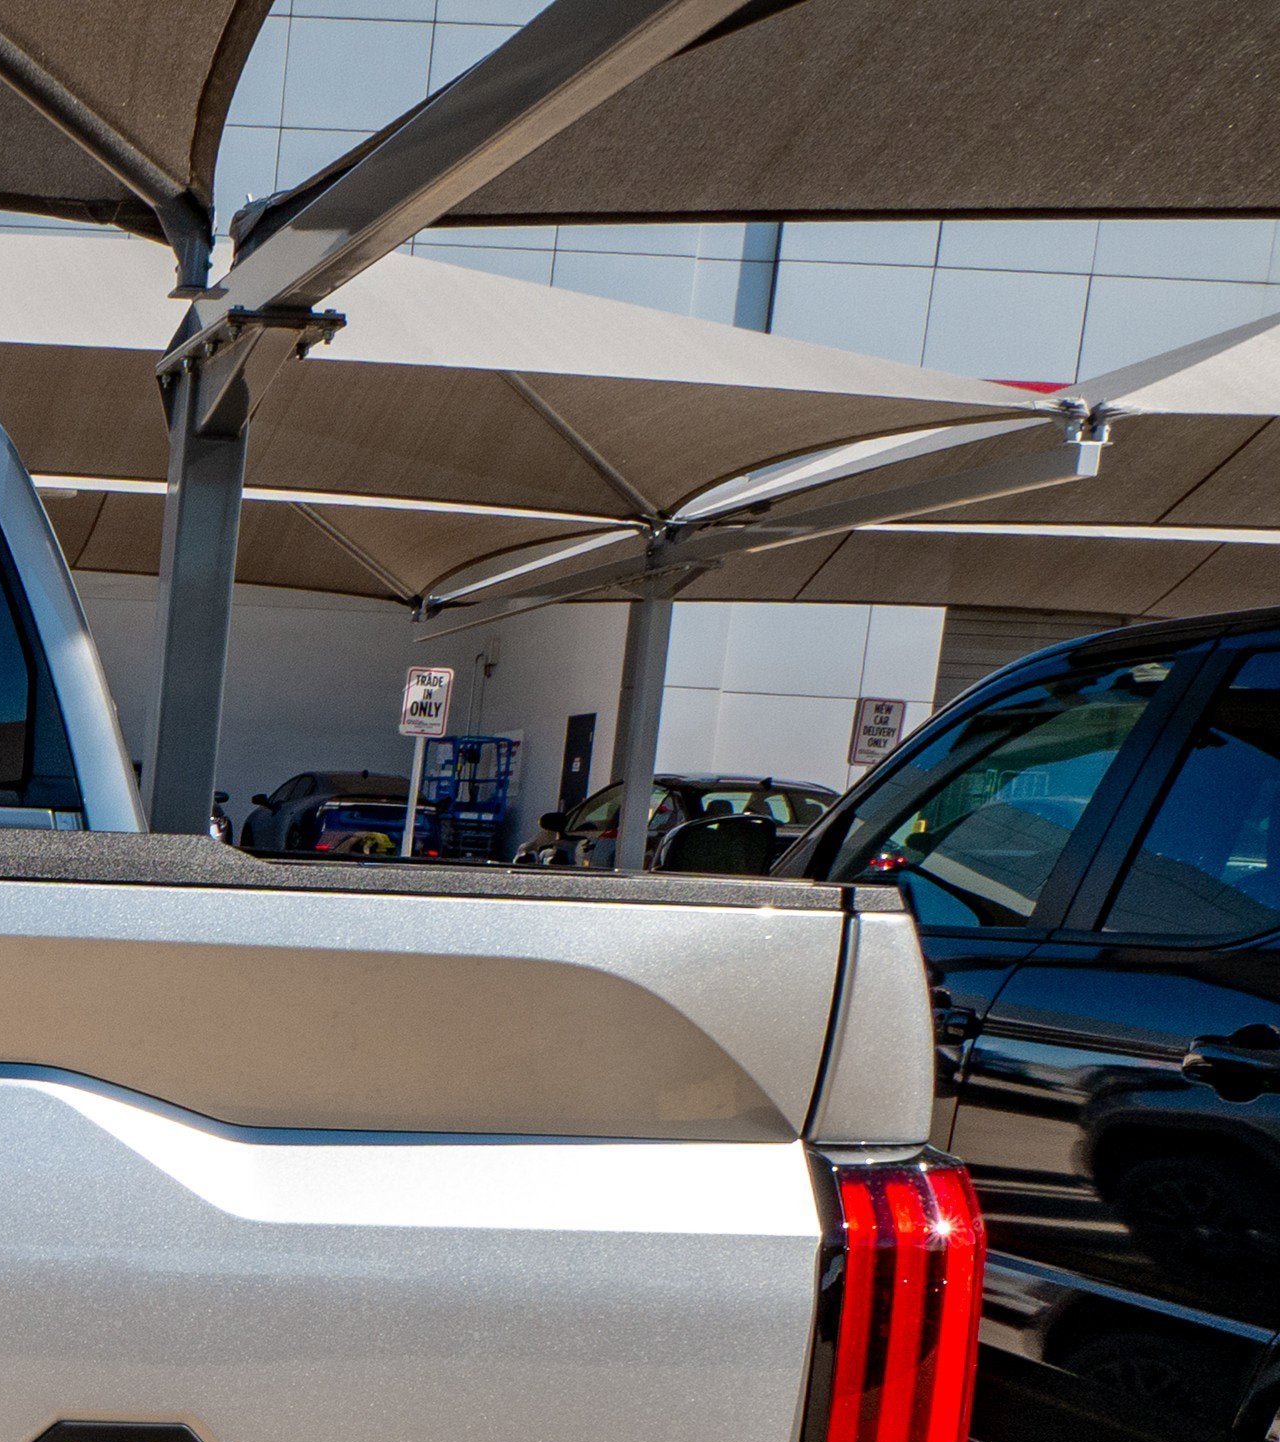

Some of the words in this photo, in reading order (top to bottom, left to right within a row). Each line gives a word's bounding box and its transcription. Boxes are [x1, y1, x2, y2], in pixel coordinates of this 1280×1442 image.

[416, 674, 444, 687] TRADE
[423, 688, 433, 700] IN
[410, 701, 442, 718] ONLY
[874, 703, 893, 714] NEW
[873, 714, 889, 725] CAR
[863, 726, 896, 737] DELIVERY
[867, 737, 888, 748] ONLY
